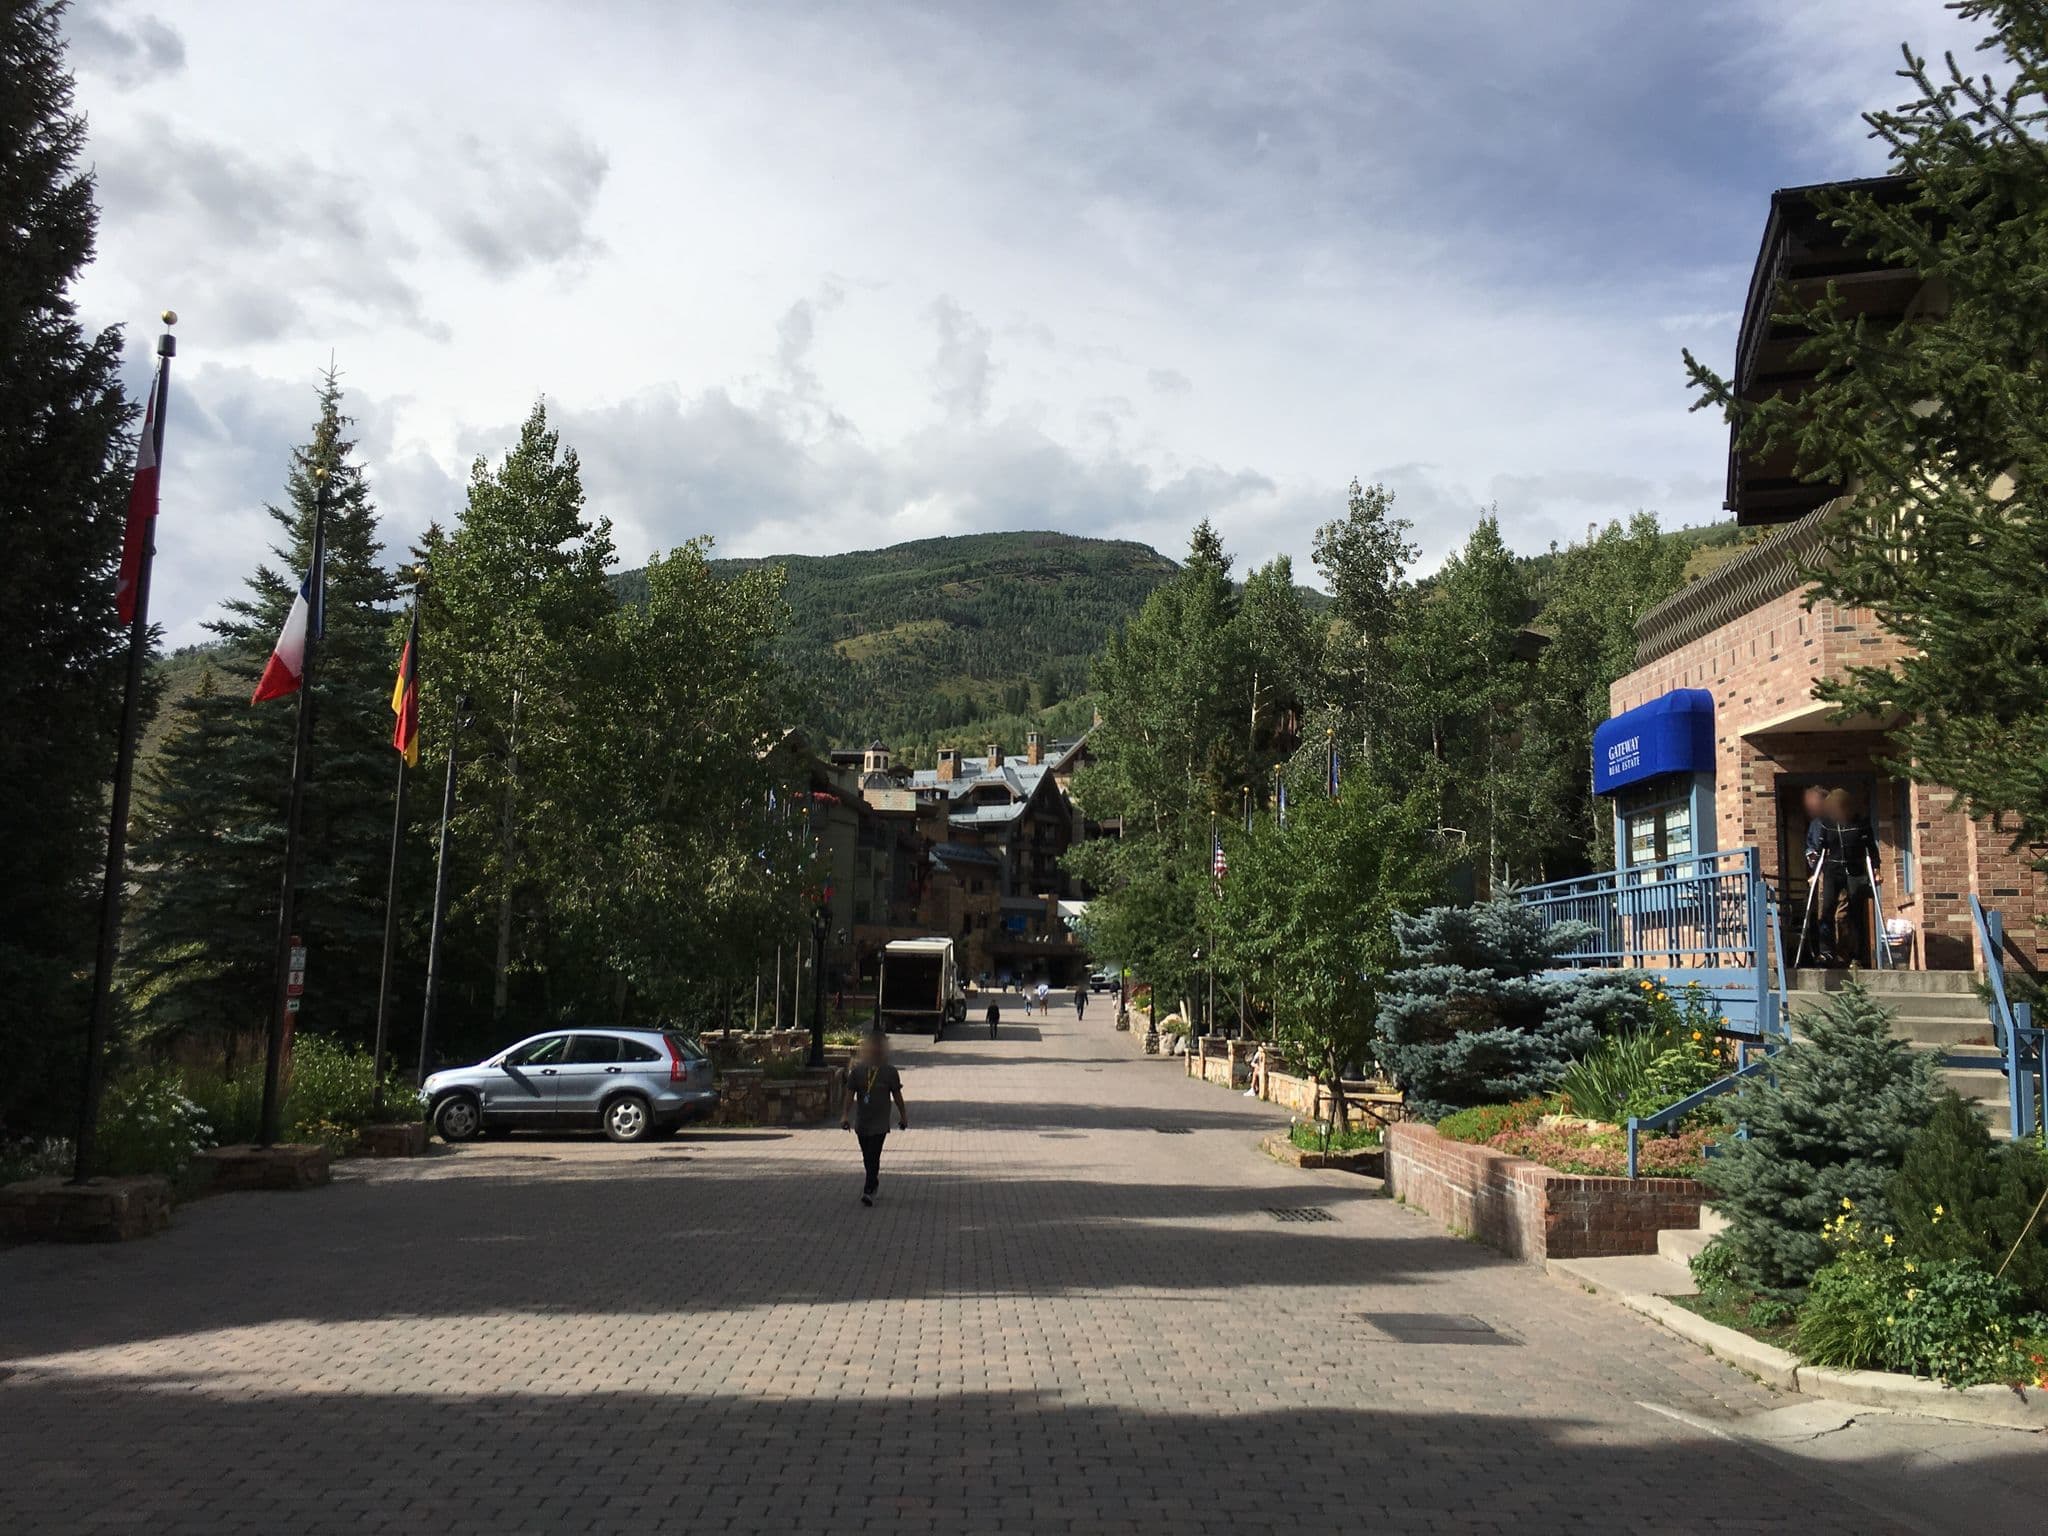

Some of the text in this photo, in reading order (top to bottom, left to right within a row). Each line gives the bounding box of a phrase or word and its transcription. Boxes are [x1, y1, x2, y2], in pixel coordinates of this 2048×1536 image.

[1608, 736, 1639, 760] GATEWAY
[1609, 764, 1620, 776] REAL
[1621, 756, 1640, 771] ESTATE
